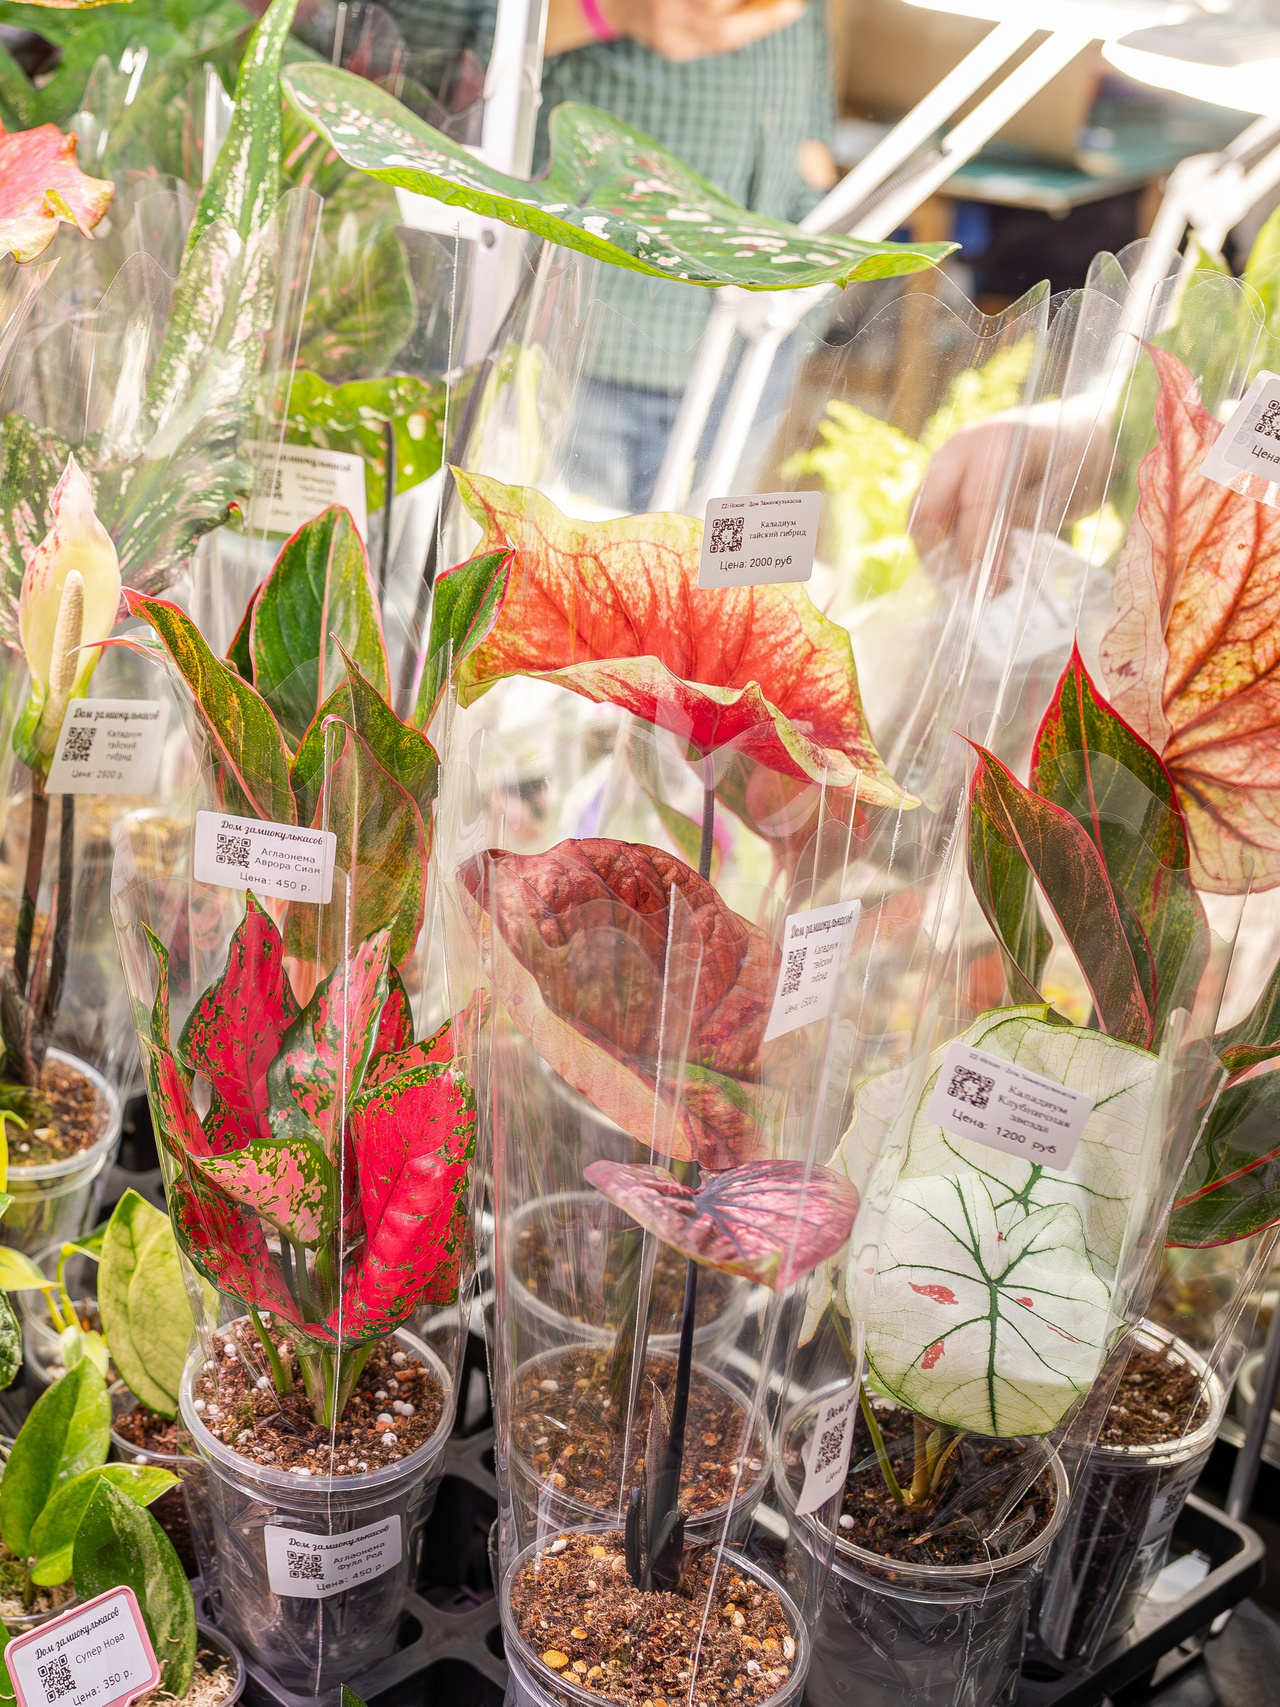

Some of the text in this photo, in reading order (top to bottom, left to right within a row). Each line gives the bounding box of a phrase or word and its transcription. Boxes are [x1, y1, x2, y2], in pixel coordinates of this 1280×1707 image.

[749, 529, 806, 539] тайский гибрид
[720, 556, 792, 571] Цена: 2000 руб
[220, 820, 324, 845] Дом замиокулькасов
[255, 858, 321, 874] Аврора Сиам
[261, 848, 315, 864] Аглаонема
[240, 872, 310, 892] Цена: 450 р.
[952, 1108, 1057, 1154] Цена: 1200 руб
[289, 1525, 389, 1551] Дом замиокулькасов
[333, 1542, 385, 1564] Аглаонема
[338, 1551, 383, 1571] Фулл Ред
[316, 1577, 348, 1591] Цена:
[351, 1568, 372, 1579] 450
[34, 1607, 120, 1660] Дом замиокулькасов
[75, 1632, 126, 1664] Супер Нова
[72, 1669, 133, 1706] Цена: 350 р.
